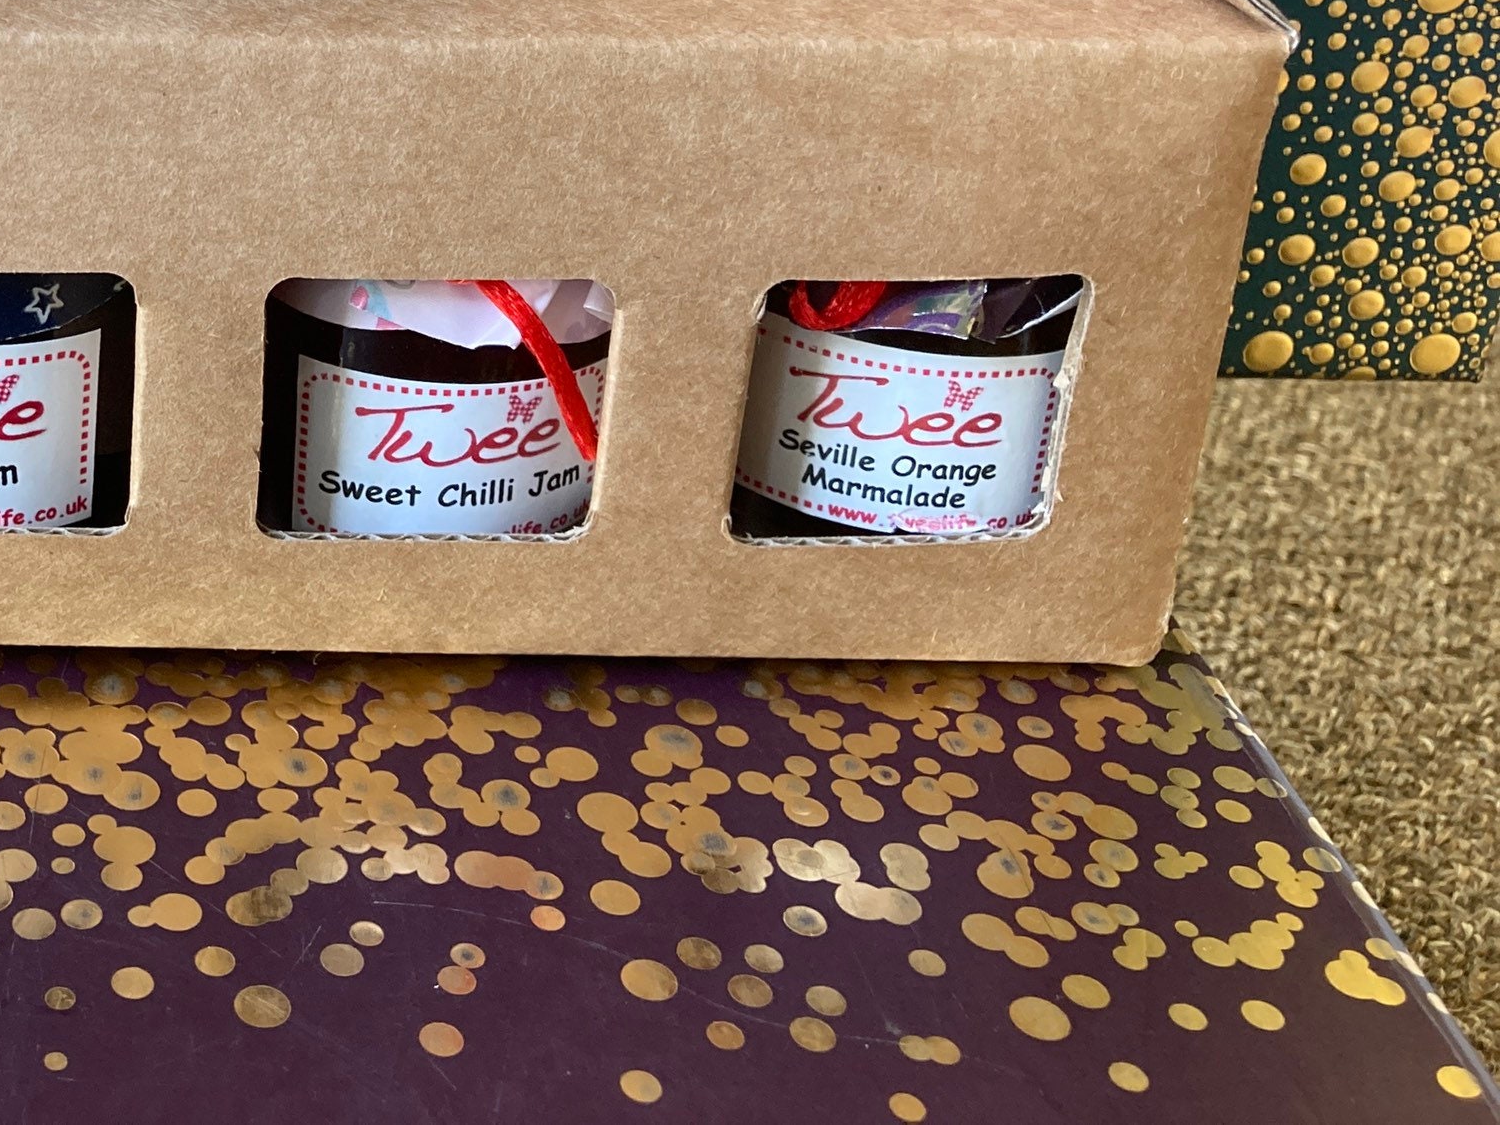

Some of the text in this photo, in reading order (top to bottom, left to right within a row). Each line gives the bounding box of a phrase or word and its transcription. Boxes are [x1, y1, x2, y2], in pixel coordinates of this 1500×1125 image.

[355, 404, 561, 467] Twee
[789, 366, 1003, 448] Twee
[318, 464, 580, 507] Sweet Chilli Jam
[778, 428, 997, 487] Seville Orange
[801, 464, 966, 508] Marmalade
